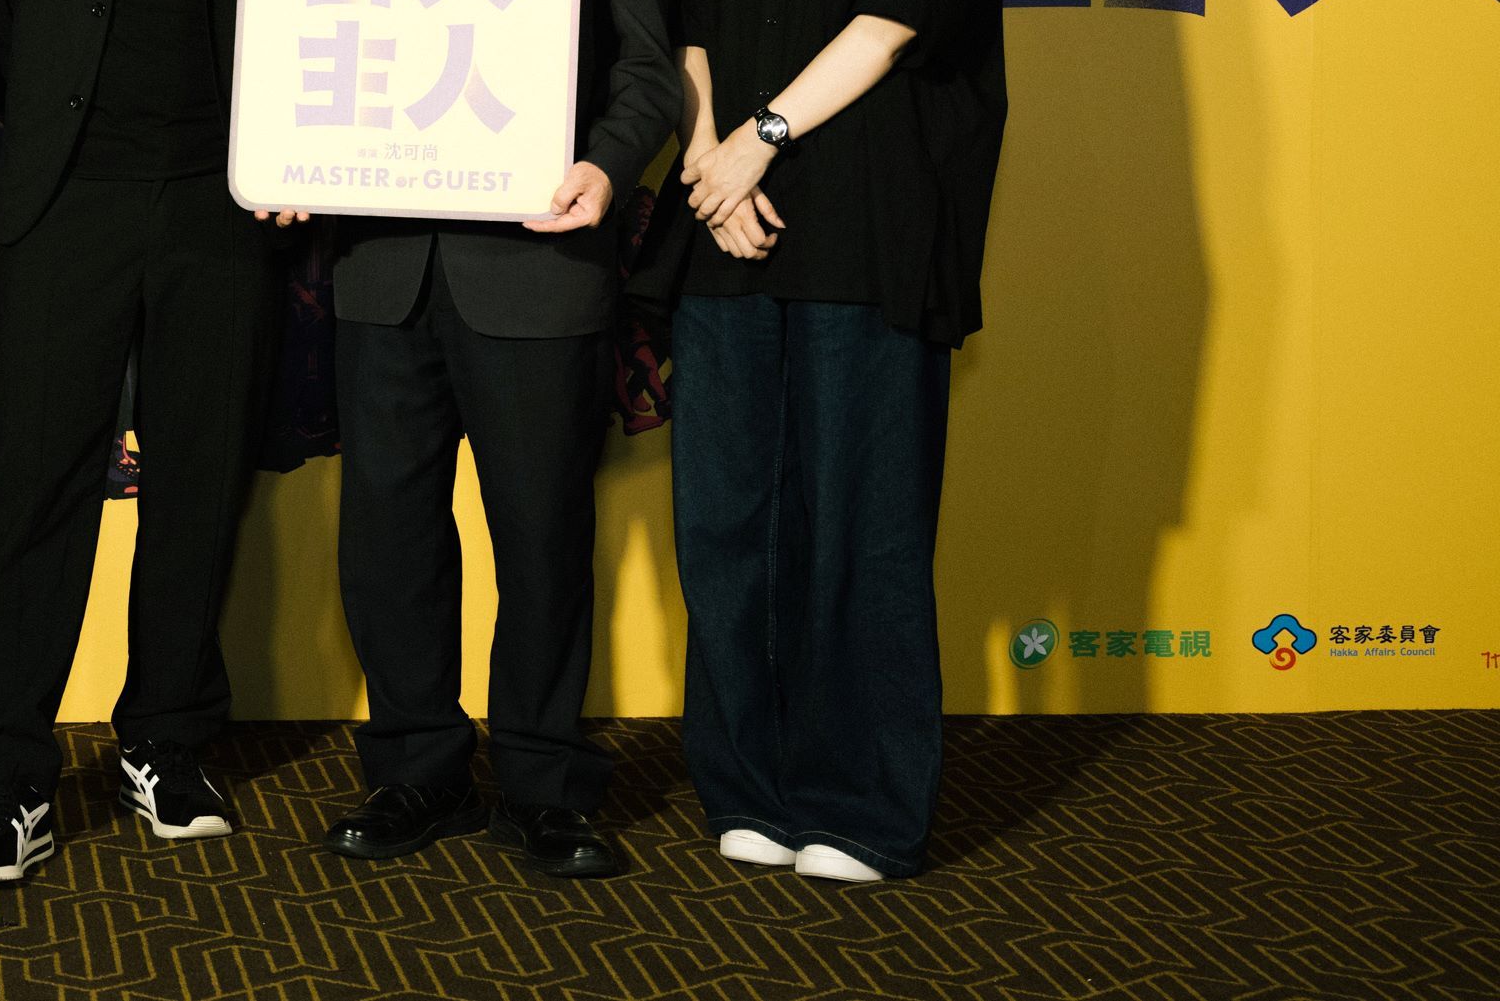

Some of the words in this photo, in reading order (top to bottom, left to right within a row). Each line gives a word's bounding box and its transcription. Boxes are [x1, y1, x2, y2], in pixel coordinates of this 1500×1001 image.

[296, 21, 516, 134] 主人
[384, 143, 439, 161] 沈可尚
[282, 165, 390, 187] MASTER
[395, 176, 418, 188] or
[423, 169, 513, 192] GUEST
[1068, 629, 1213, 658] 客家電視
[1329, 625, 1441, 644] 客家委員會
[1330, 648, 1358, 657] Hakka
[1364, 648, 1396, 657] Affairs
[1400, 647, 1435, 656] Council
